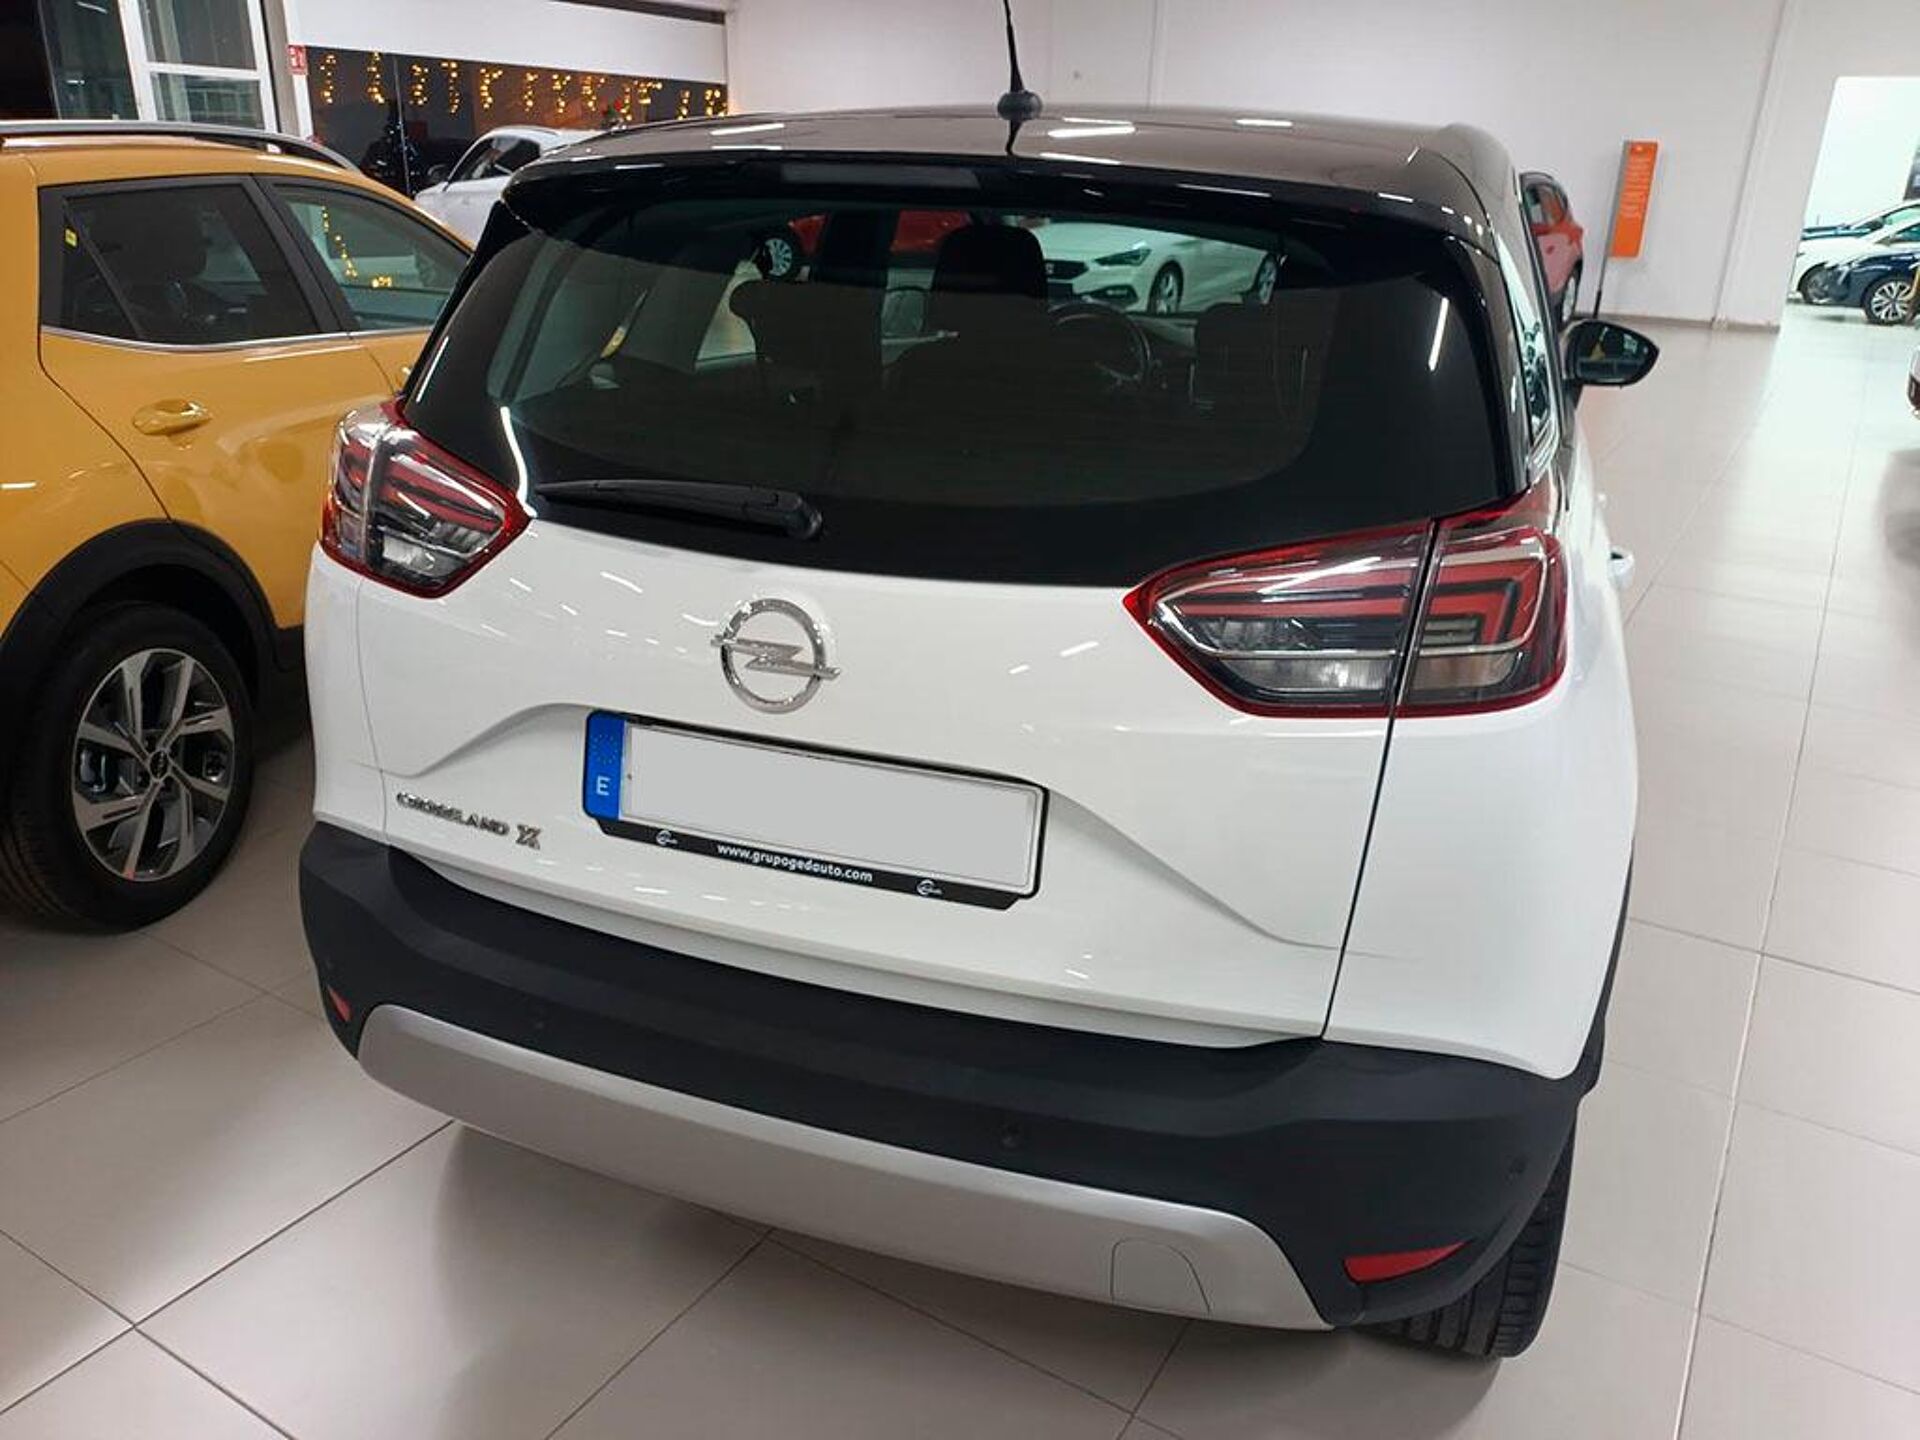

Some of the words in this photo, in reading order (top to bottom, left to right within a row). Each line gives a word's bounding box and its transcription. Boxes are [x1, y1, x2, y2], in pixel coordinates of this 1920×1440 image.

[597, 775, 611, 796] E
[516, 823, 541, 850] X
[717, 844, 873, 882] www.grupogedauto.com
